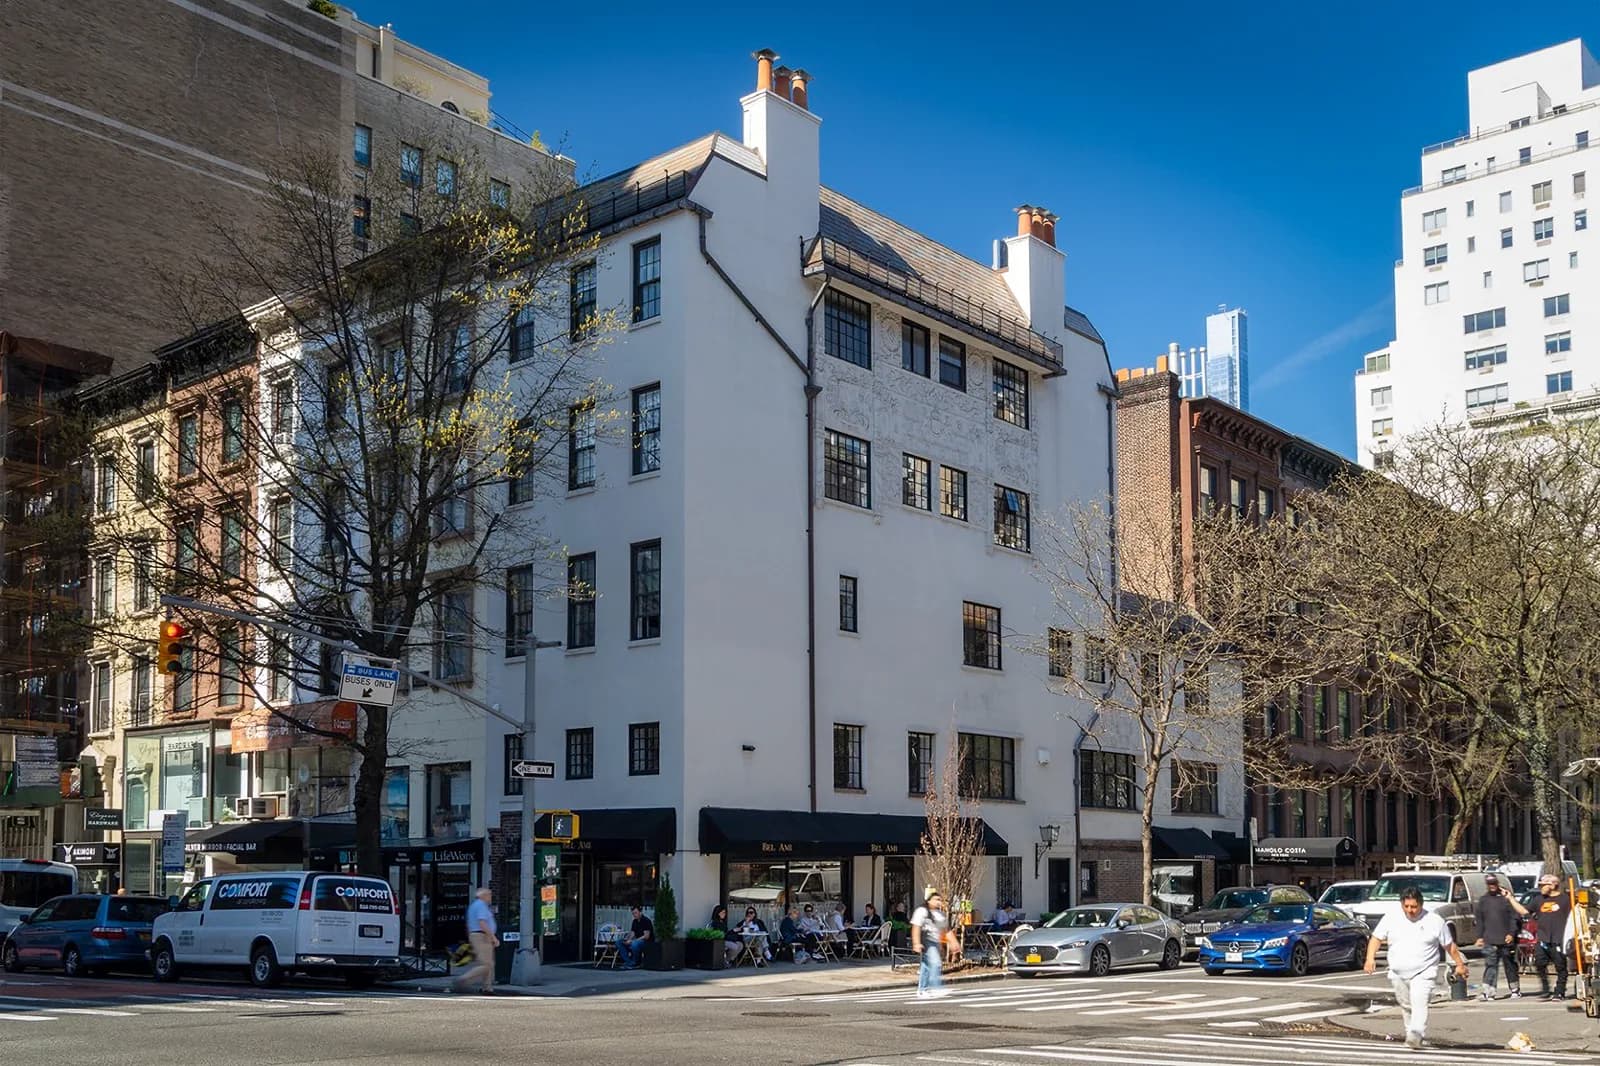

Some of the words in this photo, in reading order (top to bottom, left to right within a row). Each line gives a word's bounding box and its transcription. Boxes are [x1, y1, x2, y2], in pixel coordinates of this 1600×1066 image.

[358, 668, 373, 676] BUS
[374, 670, 394, 679] LANE
[345, 675, 371, 686] BUSES
[374, 680, 394, 689] ONLY
[536, 766, 551, 774] WAY
[246, 843, 257, 851] BAR
[219, 882, 273, 898] COMFORT
[335, 886, 389, 899] COMFORT
